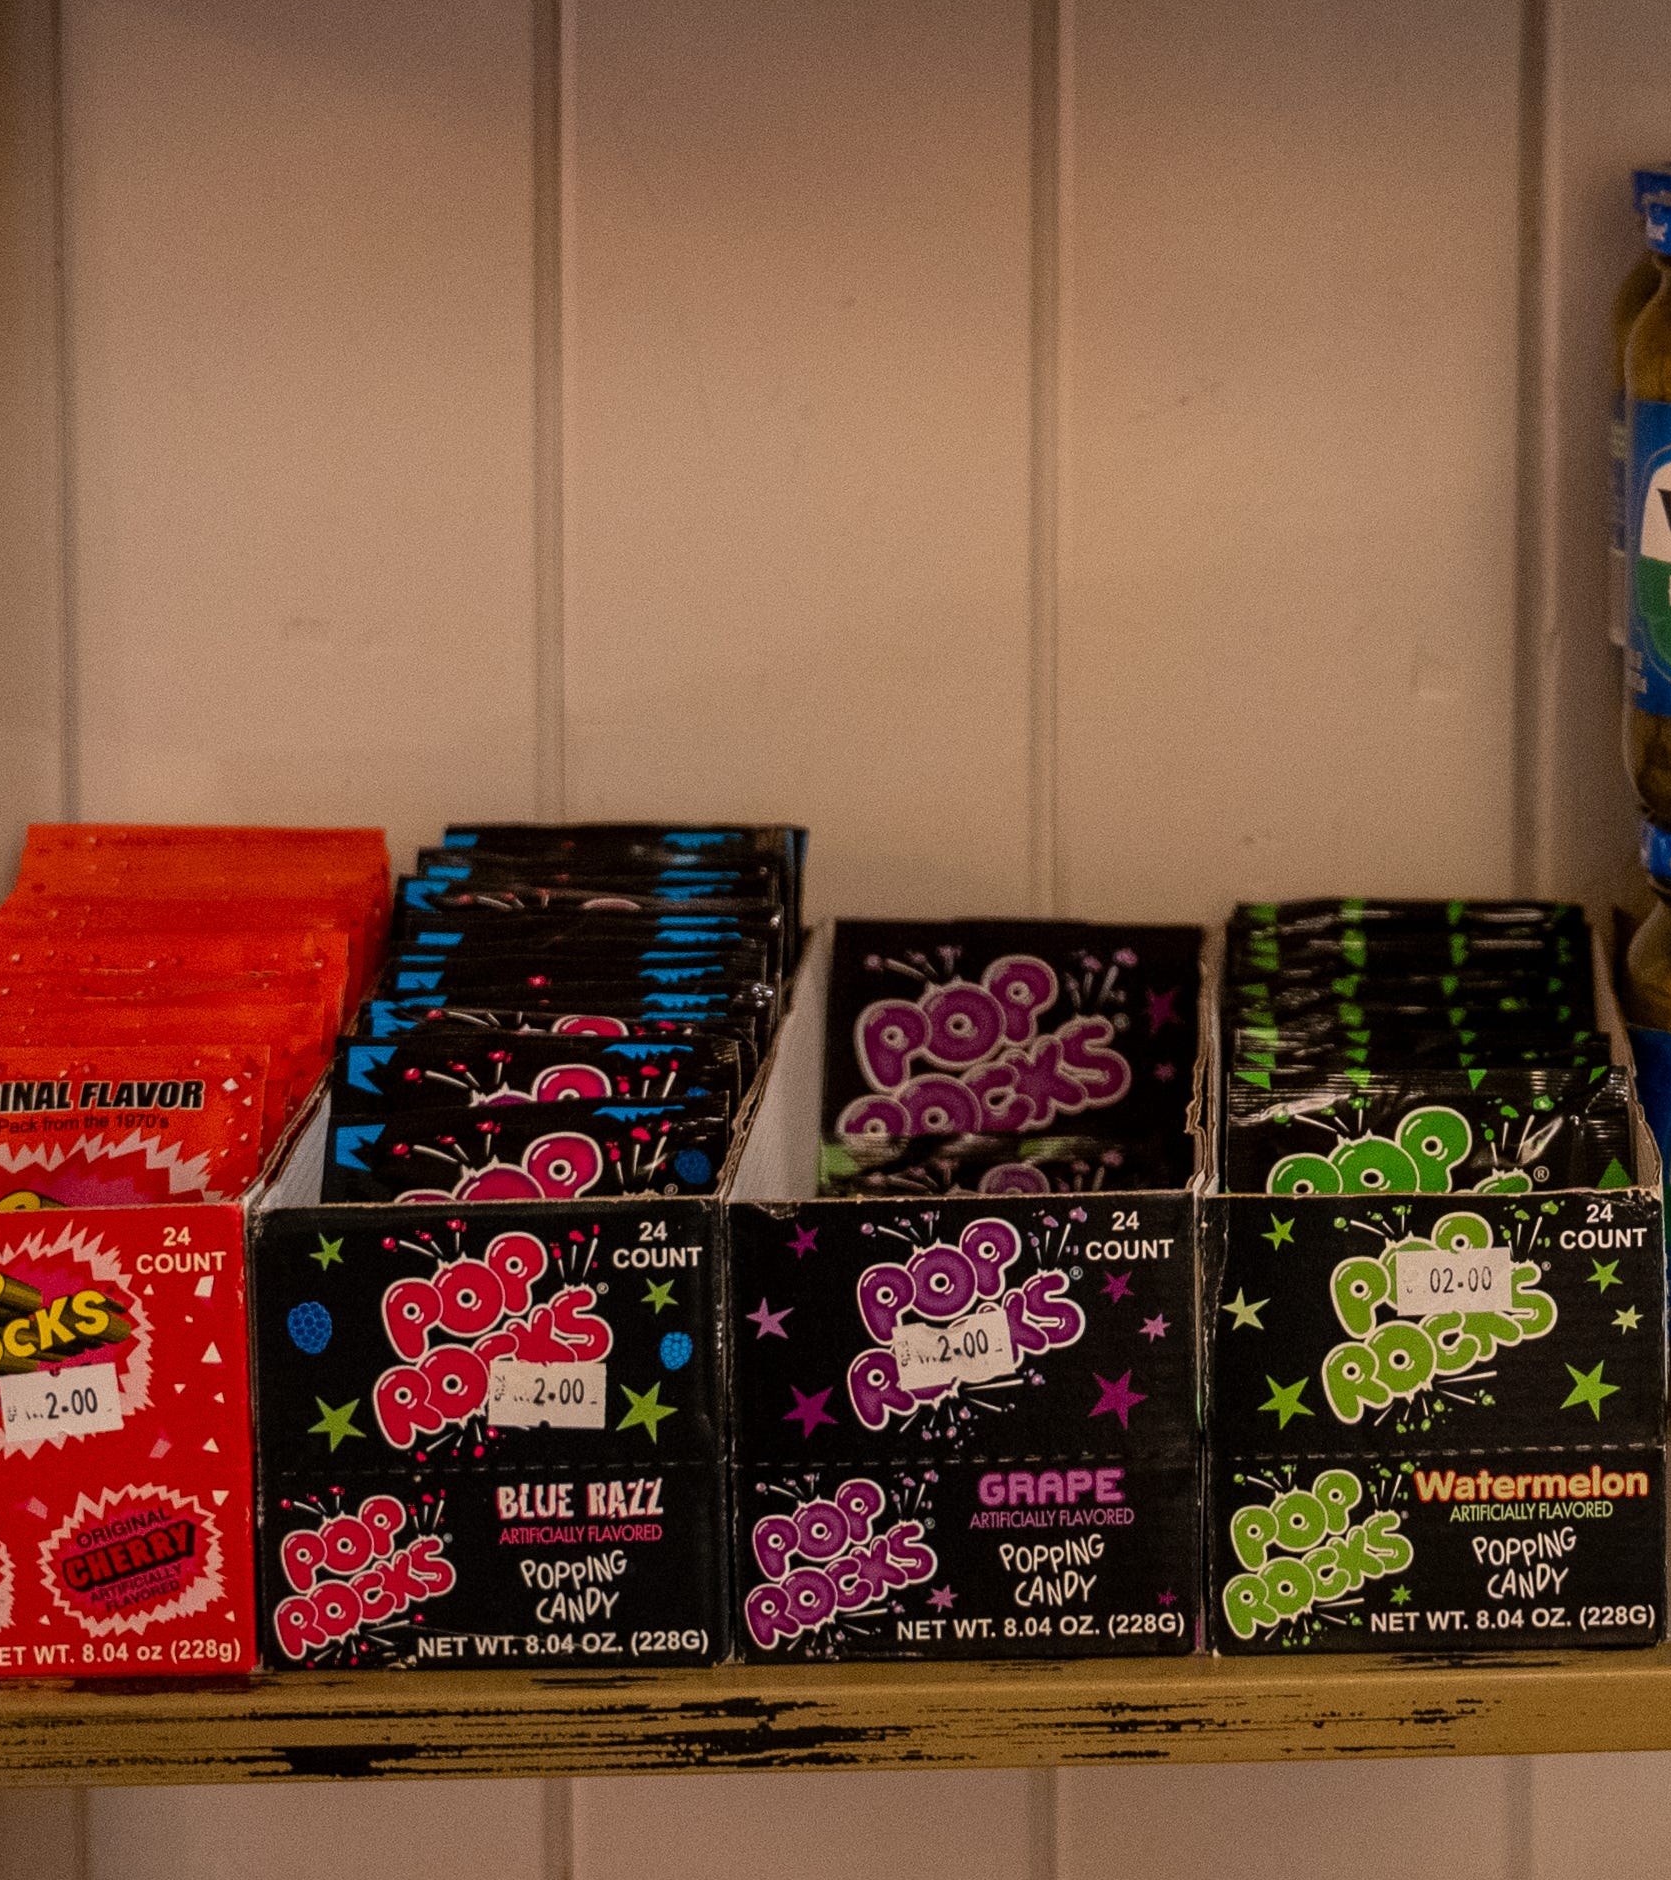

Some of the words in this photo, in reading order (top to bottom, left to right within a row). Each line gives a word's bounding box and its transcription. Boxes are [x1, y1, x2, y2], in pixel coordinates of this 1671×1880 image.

[79, 1080, 205, 1110] FLAVOR
[162, 1227, 191, 1247] 24
[136, 1251, 226, 1275] COUNT
[496, 1483, 573, 1519] BLUE
[588, 1477, 663, 1518] RAZZ
[978, 1468, 1126, 1507] GRAPE
[1414, 1465, 1649, 1502] Watermelon
[499, 1525, 584, 1544] ARTIFICIALLY
[587, 1524, 662, 1542] FLAVORED
[1231, 1469, 1361, 1571] POP
[999, 1533, 1105, 1571] POPPING
[1014, 1571, 1097, 1607] CANDY
[1222, 1510, 1413, 1639] ROCKS
[33, 1644, 75, 1665] WT.
[81, 1643, 129, 1662] 8.04
[136, 1645, 163, 1661] oz
[169, 1640, 241, 1663] (228g)
